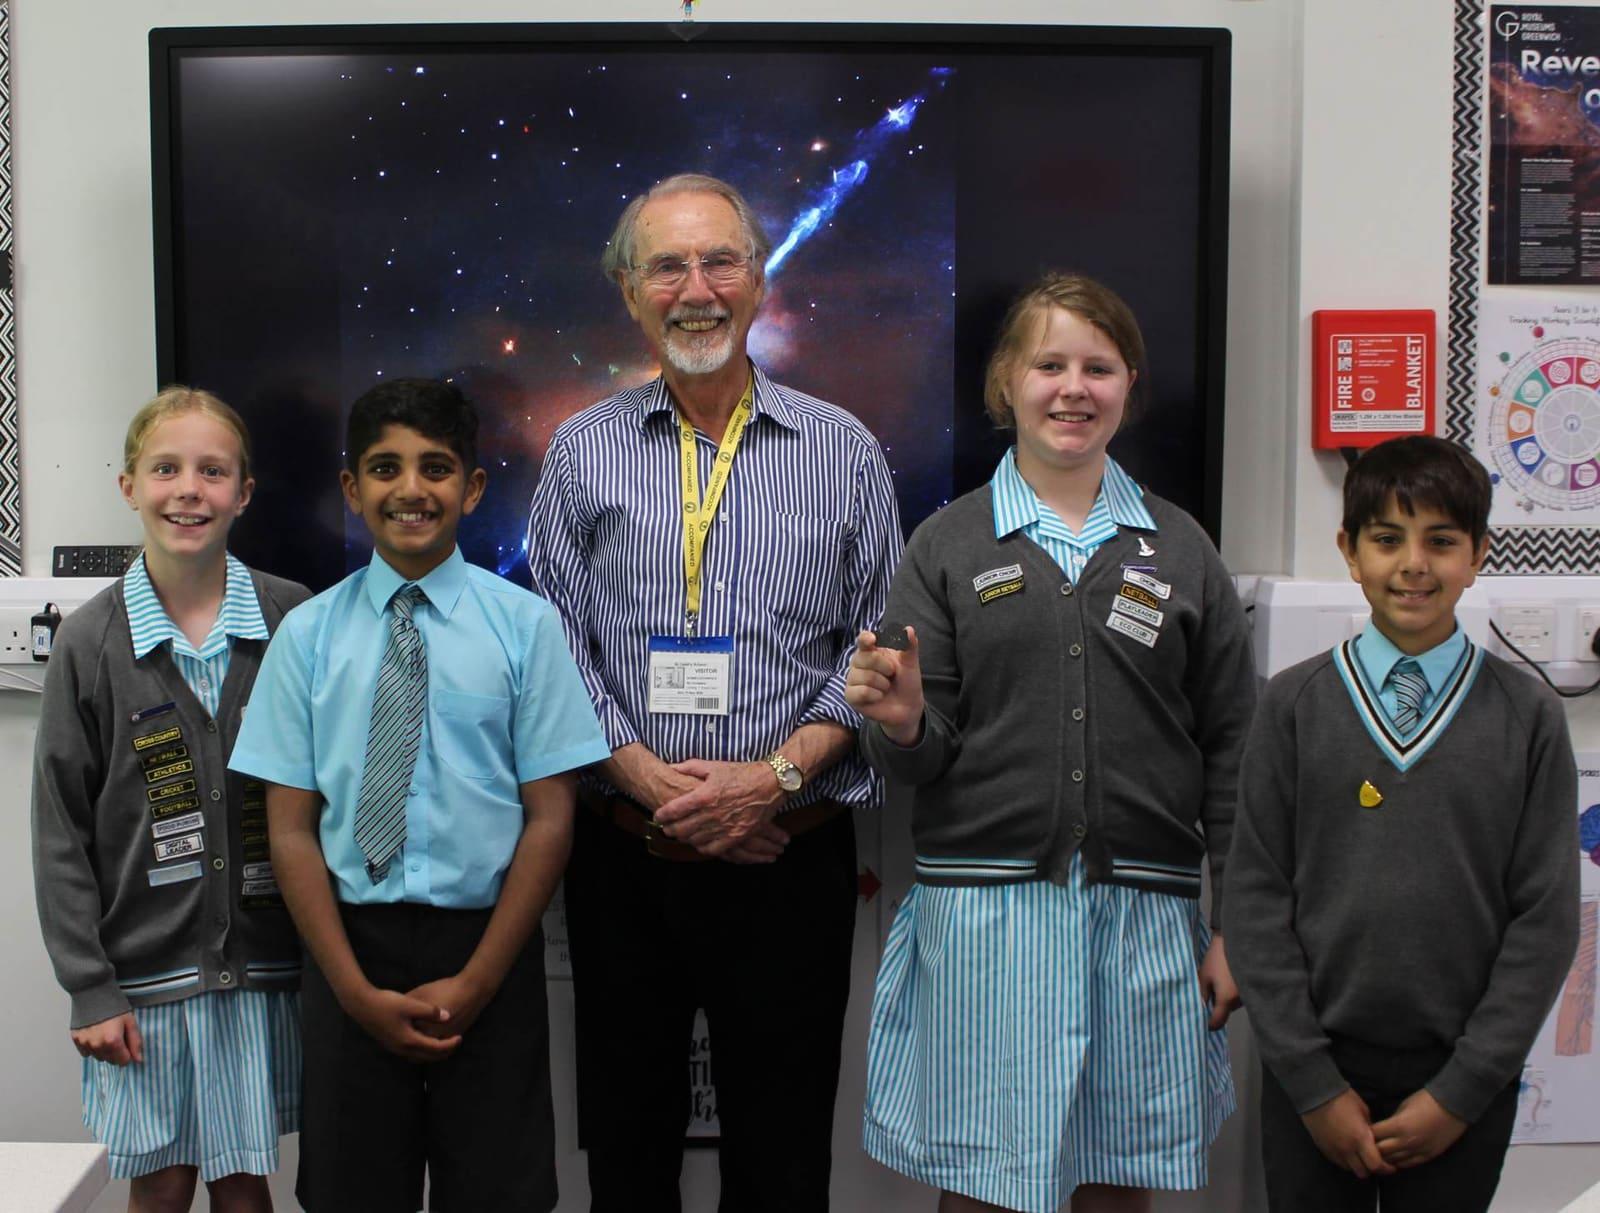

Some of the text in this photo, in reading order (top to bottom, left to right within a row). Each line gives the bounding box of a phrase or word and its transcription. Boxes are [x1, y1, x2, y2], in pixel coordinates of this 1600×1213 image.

[1521, 13, 1543, 21] ROYAL
[1520, 22, 1556, 31] MUSEUMS
[1521, 32, 1561, 41] GREENWICH
[1521, 49, 1600, 75] Reve
[1406, 336, 1421, 408] BLANKET
[1337, 375, 1352, 408] FIRE
[706, 470, 723, 511] ACCOMPANIED
[1124, 587, 1156, 606] NETBALL
[1119, 620, 1149, 638] ECO CLUB
[153, 764, 187, 777] ATHLETICS
[160, 784, 185, 796] CRICKET
[159, 802, 193, 815] FOOTBALL
[166, 839, 189, 849] DIGITAL
[167, 844, 192, 855] LEADER
